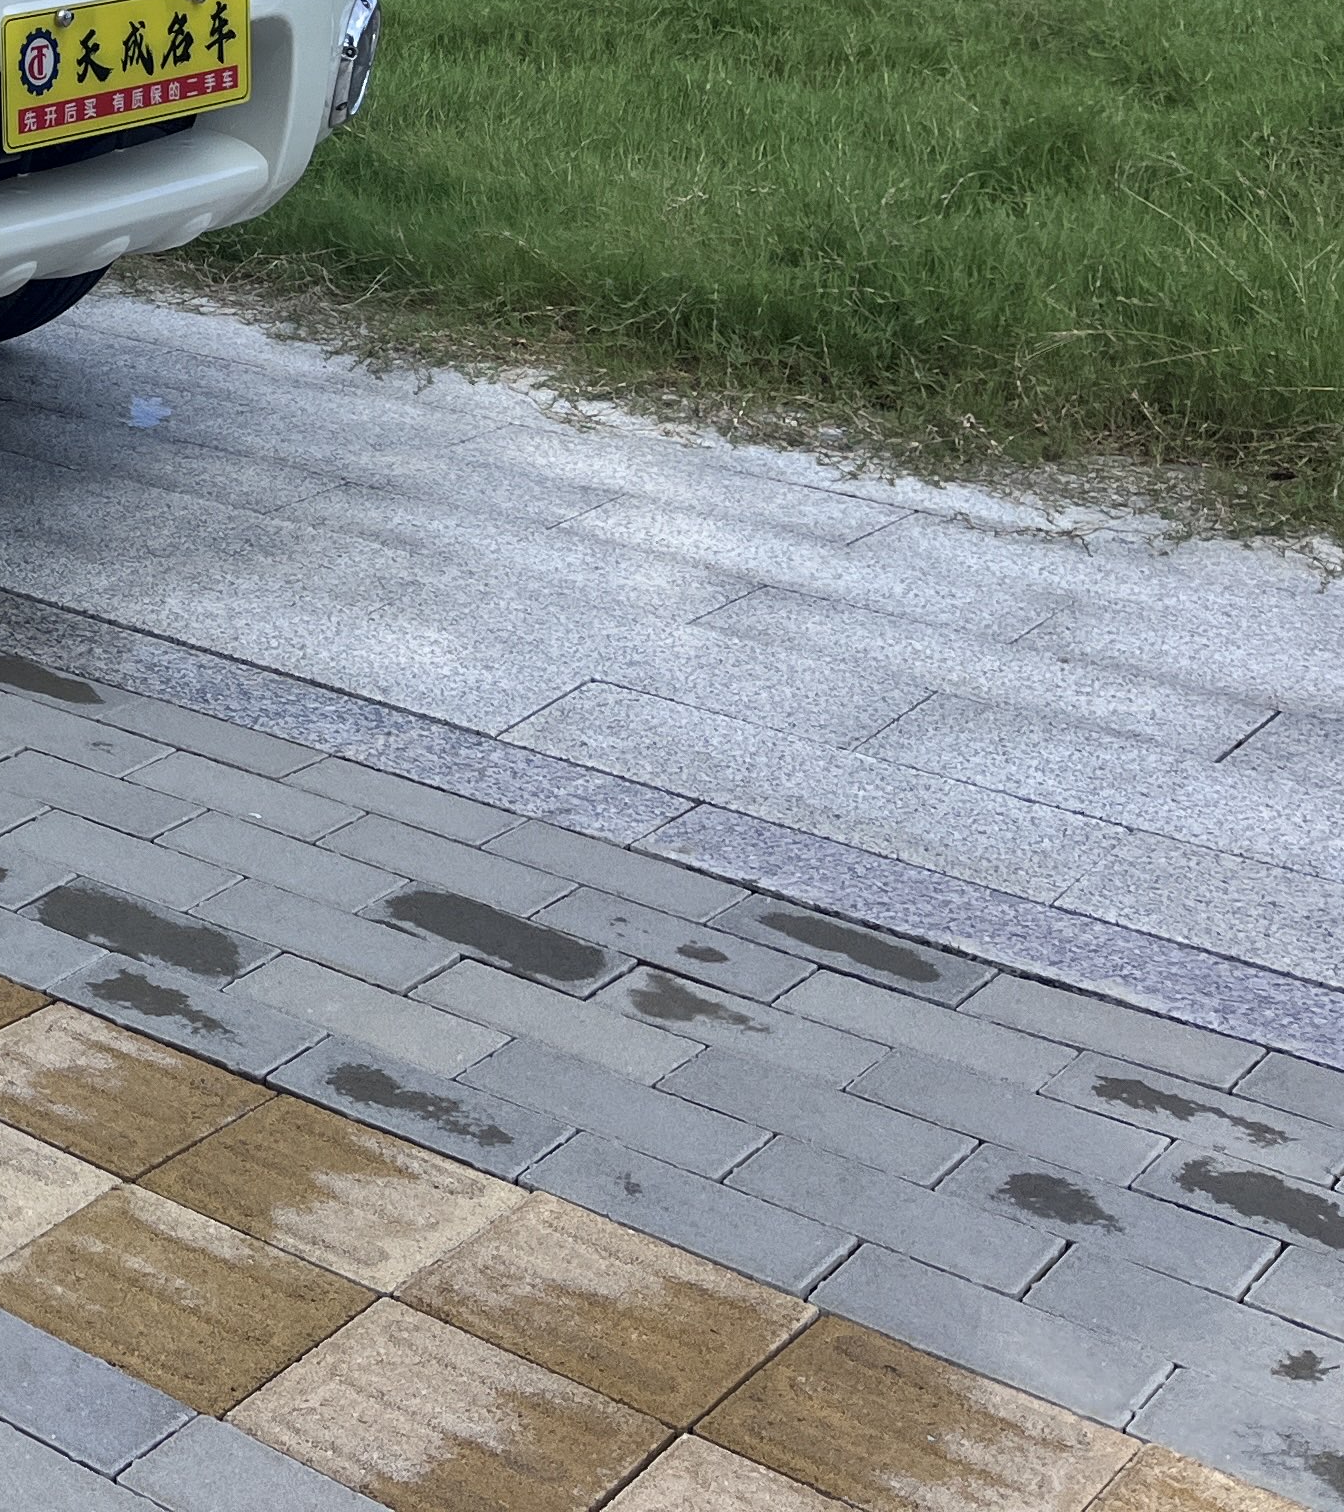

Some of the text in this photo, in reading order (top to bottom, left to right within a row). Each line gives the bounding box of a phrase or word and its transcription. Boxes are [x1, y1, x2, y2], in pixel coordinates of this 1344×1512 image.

[76, 0, 237, 84] 天成名车
[23, 70, 235, 131] 先开后买 有质保的二手车
